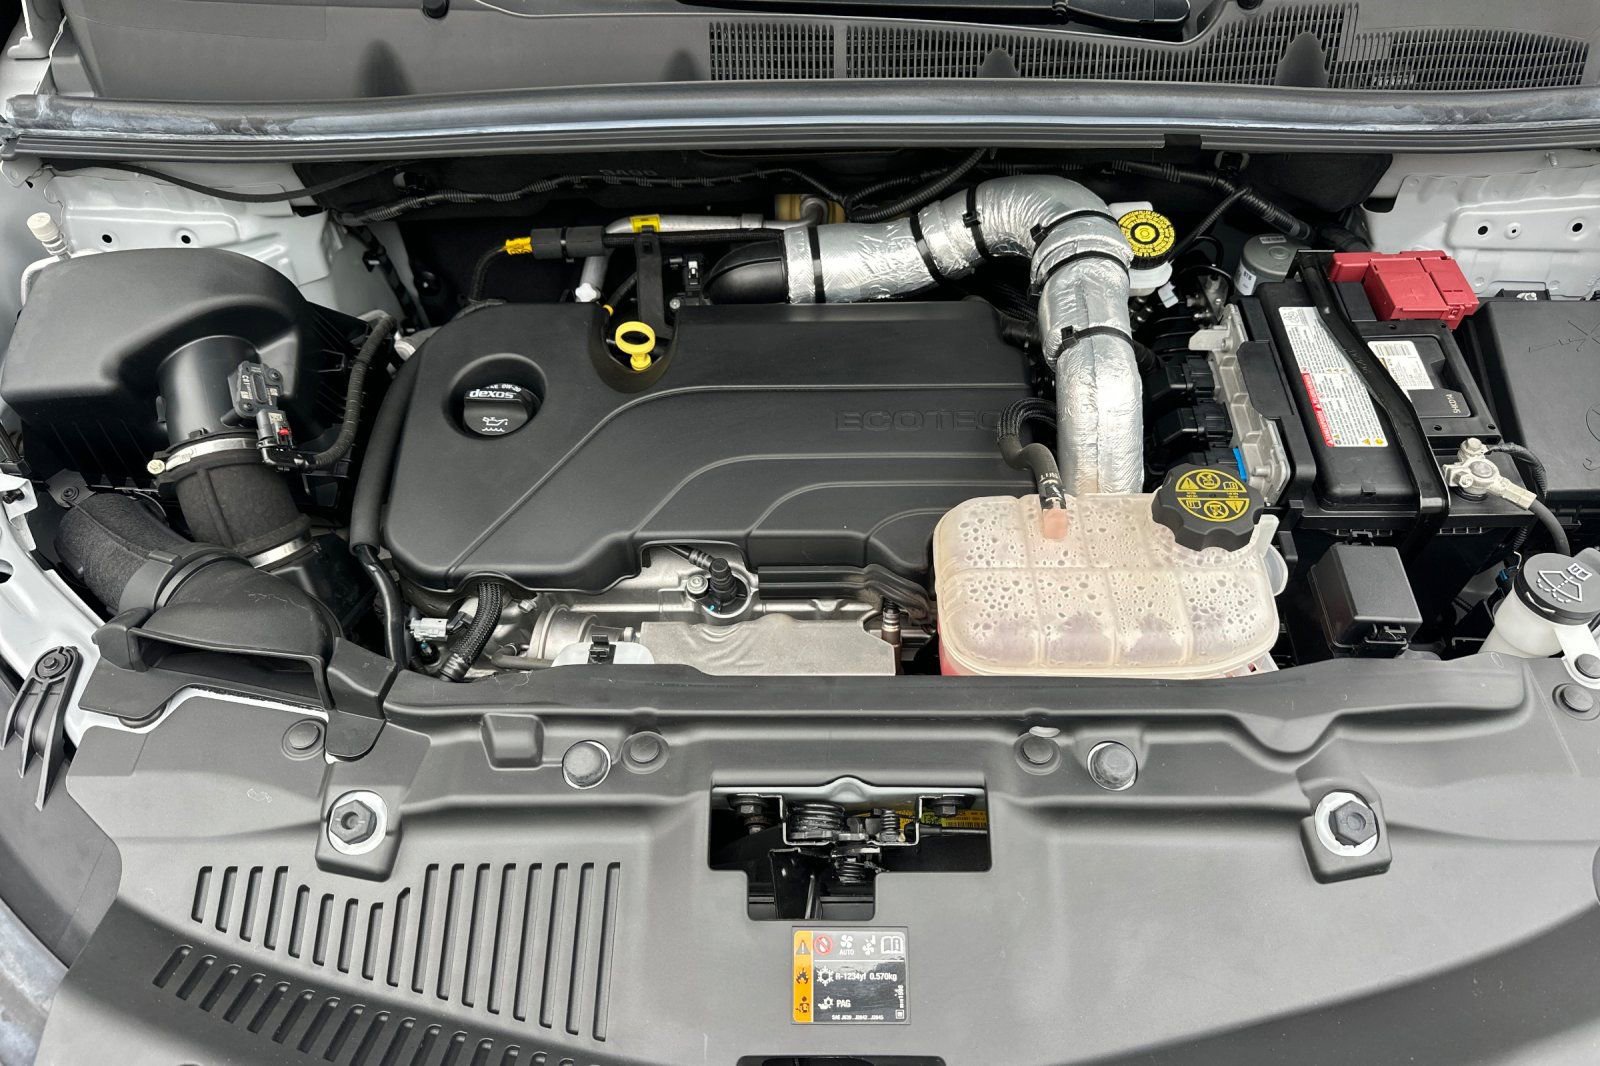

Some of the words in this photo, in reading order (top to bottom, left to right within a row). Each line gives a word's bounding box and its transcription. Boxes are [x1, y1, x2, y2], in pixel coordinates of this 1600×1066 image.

[469, 389, 516, 398] dexos
[836, 410, 1001, 431] ECOTEC
[835, 972, 866, 981] R-1234yf
[869, 972, 897, 981] 0.570kg
